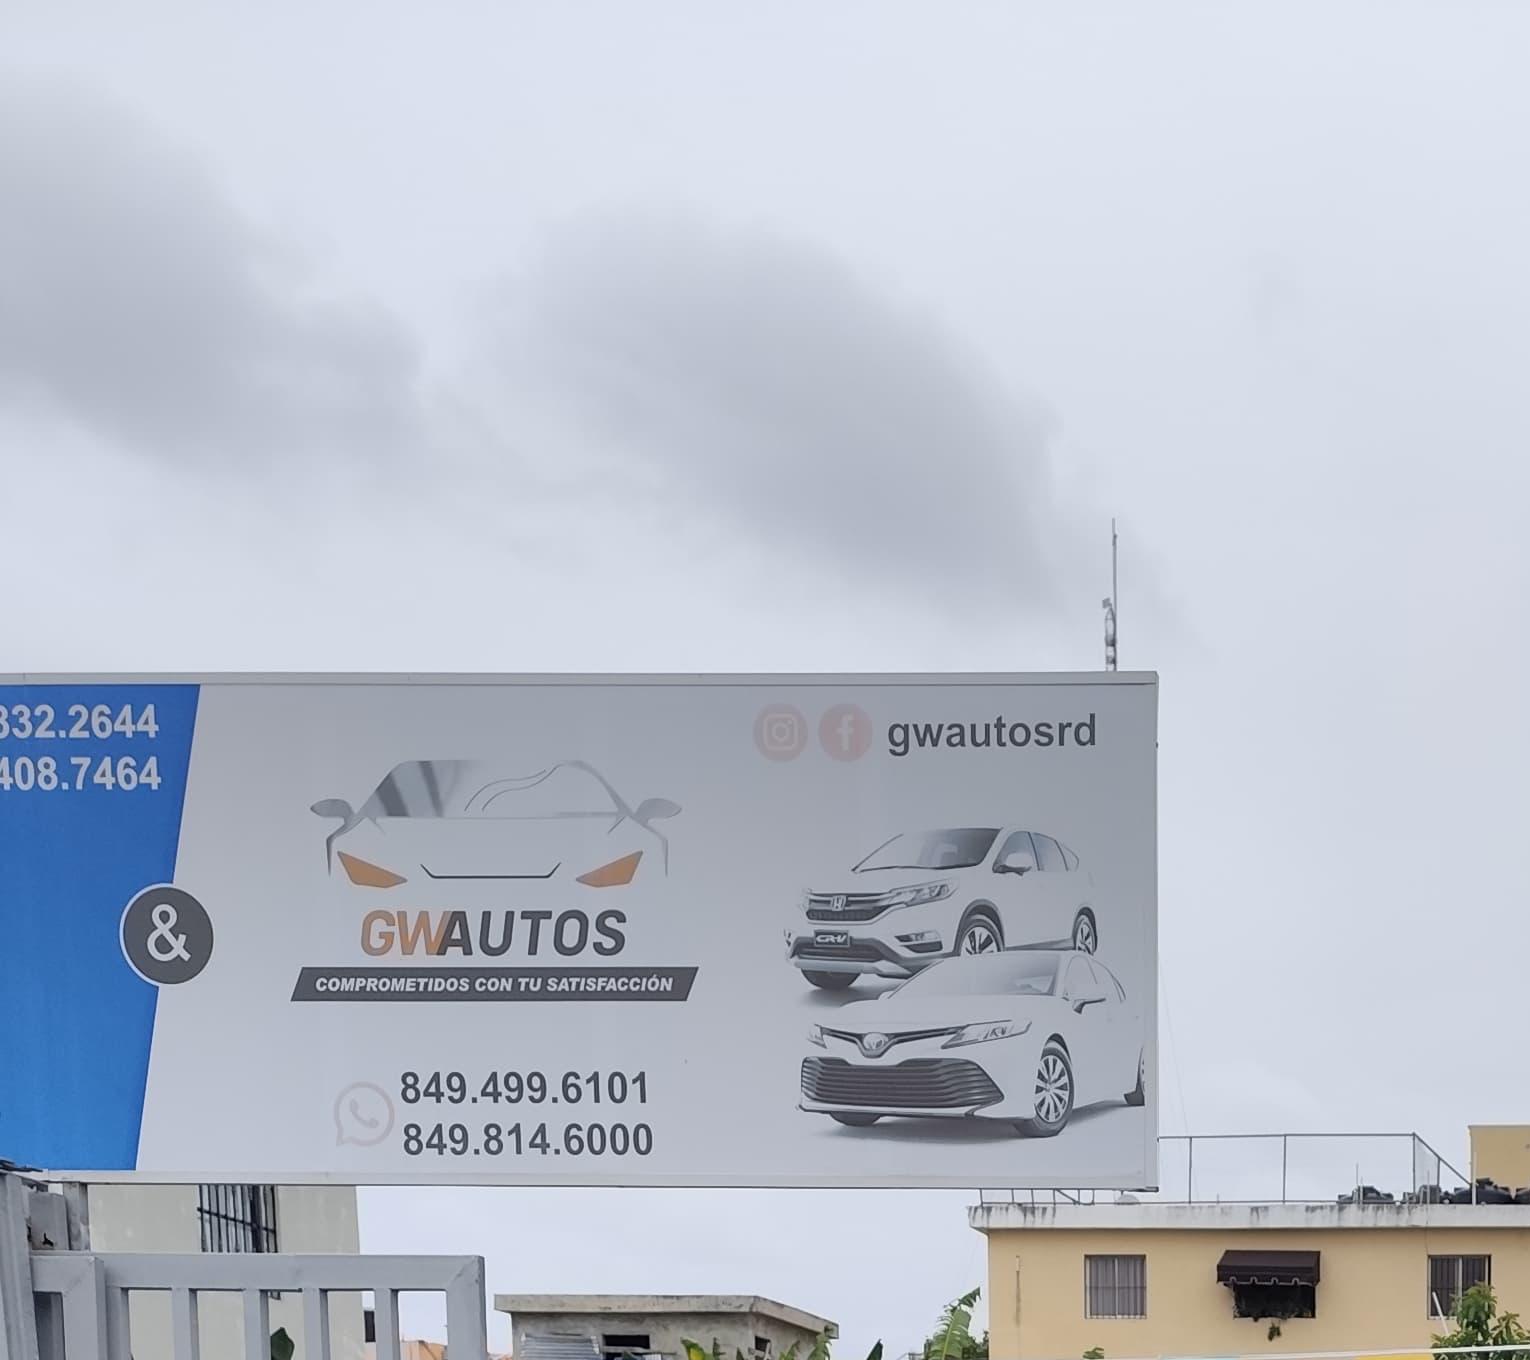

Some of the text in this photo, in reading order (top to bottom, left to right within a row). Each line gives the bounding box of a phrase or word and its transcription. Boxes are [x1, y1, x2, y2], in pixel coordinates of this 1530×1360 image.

[888, 712, 1096, 757] gwautosrd
[146, 903, 192, 963] &
[360, 909, 628, 957] GWAUTOS
[315, 974, 674, 992] COMPROMETIDOS CON TU SATISFACCIÓN
[400, 1070, 648, 1105] 849.499.6101
[402, 1122, 654, 1156] 849.814.6000
